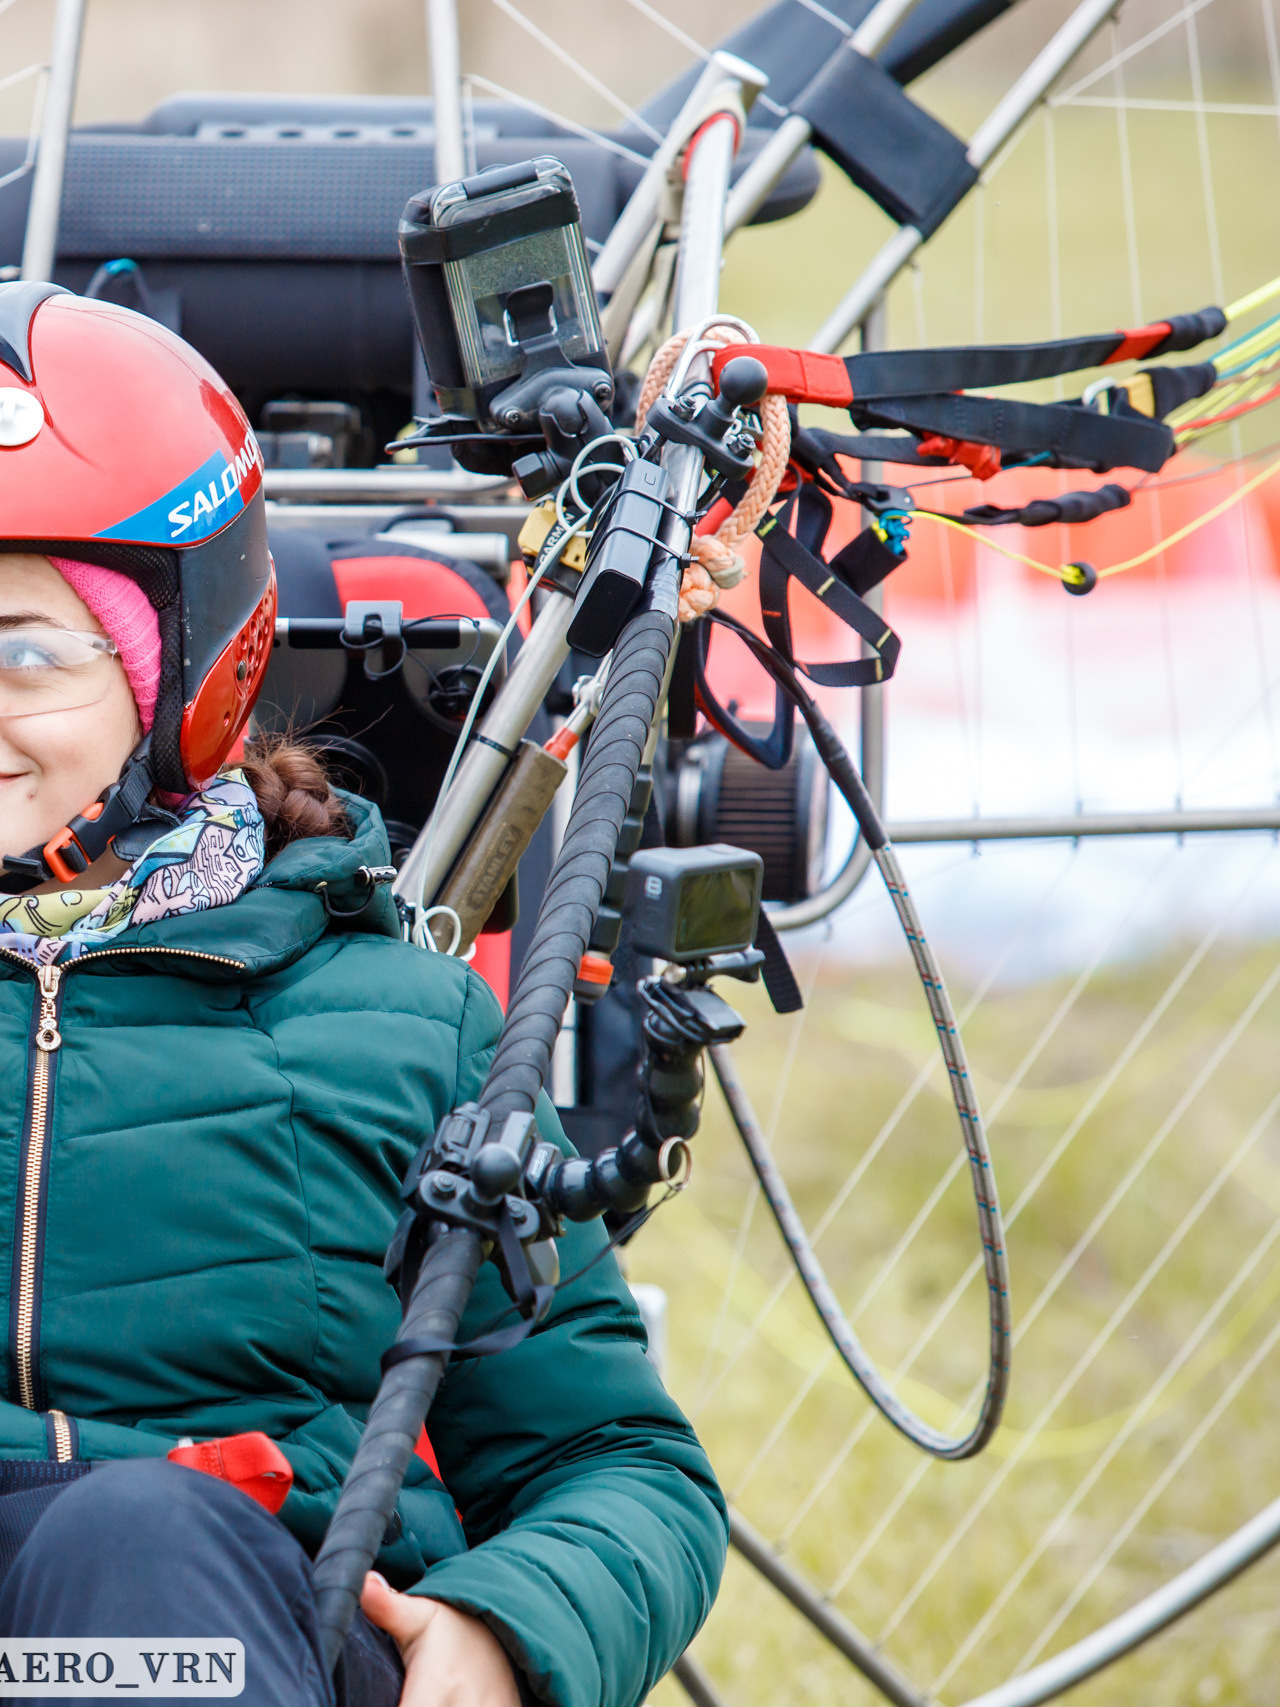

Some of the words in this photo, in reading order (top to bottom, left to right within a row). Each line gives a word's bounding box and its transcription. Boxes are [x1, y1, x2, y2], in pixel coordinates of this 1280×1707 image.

[168, 427, 261, 538] SALOMO
[540, 512, 576, 564] GARMN
[470, 826, 517, 905] STANLEY
